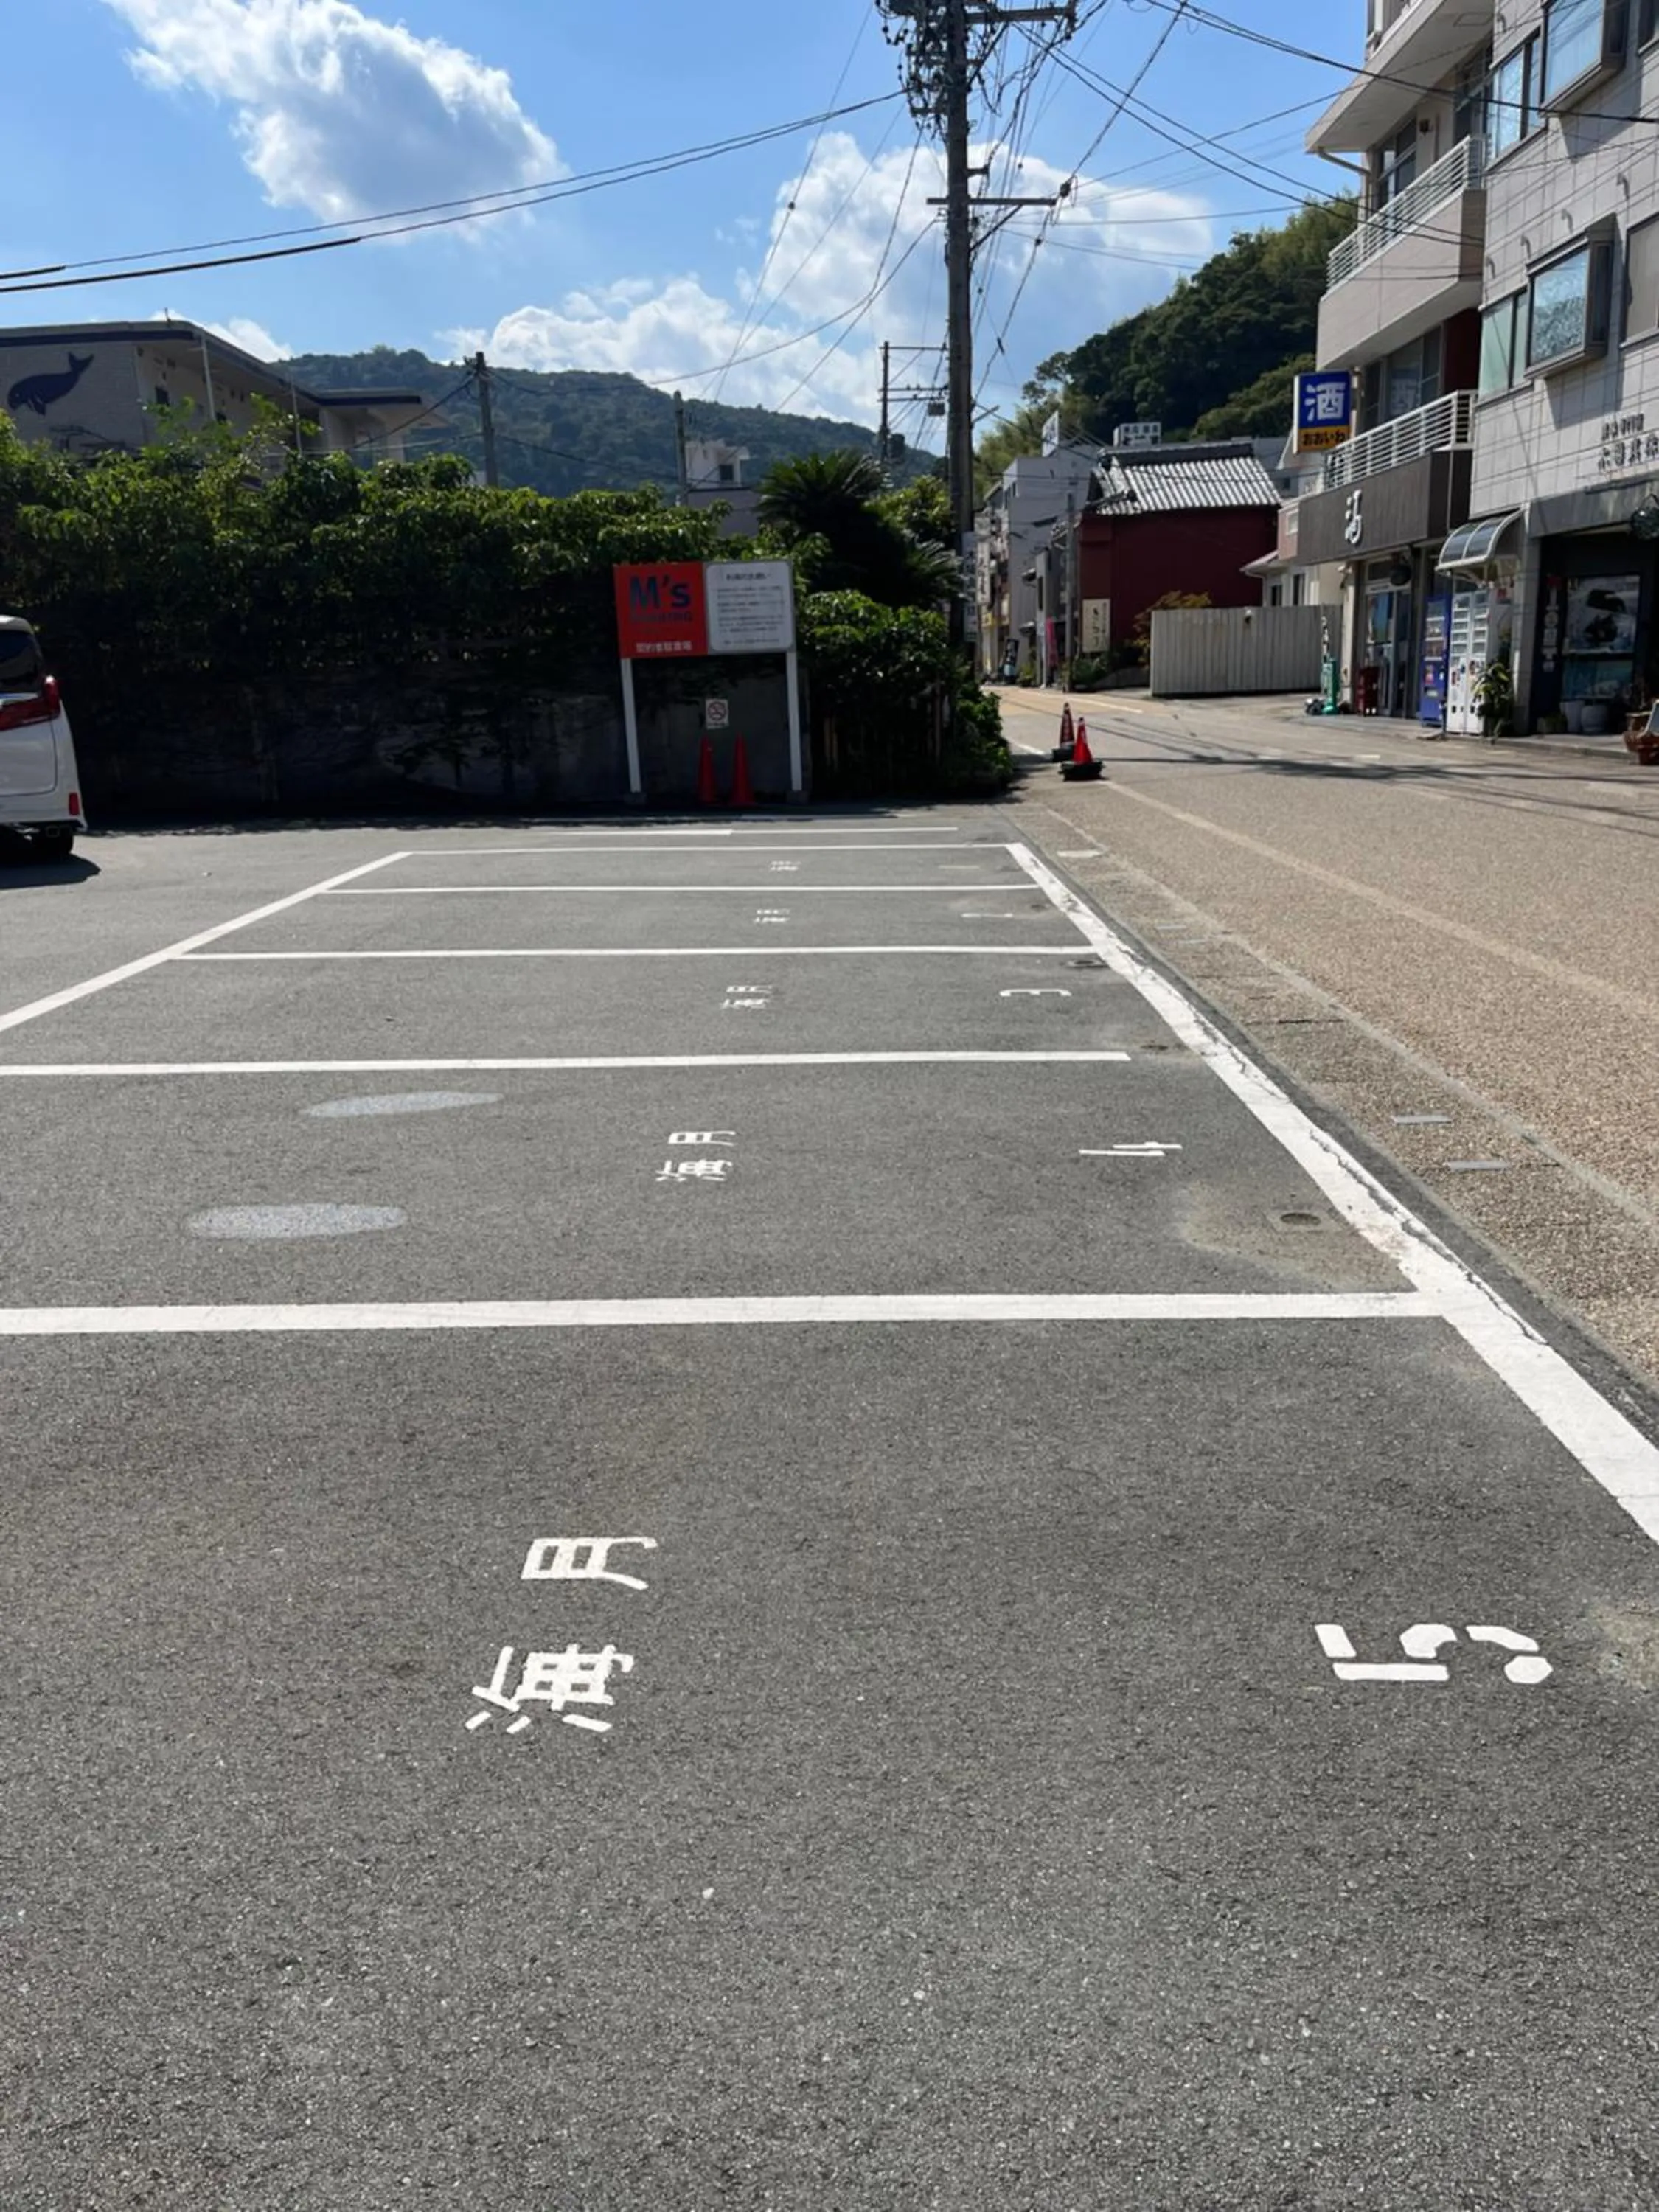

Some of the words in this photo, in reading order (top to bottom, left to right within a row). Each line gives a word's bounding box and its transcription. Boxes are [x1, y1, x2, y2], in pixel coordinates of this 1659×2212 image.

[1304, 381, 1346, 422] 酒
[629, 574, 692, 609] M's
[1314, 1624, 1554, 1684] 5
